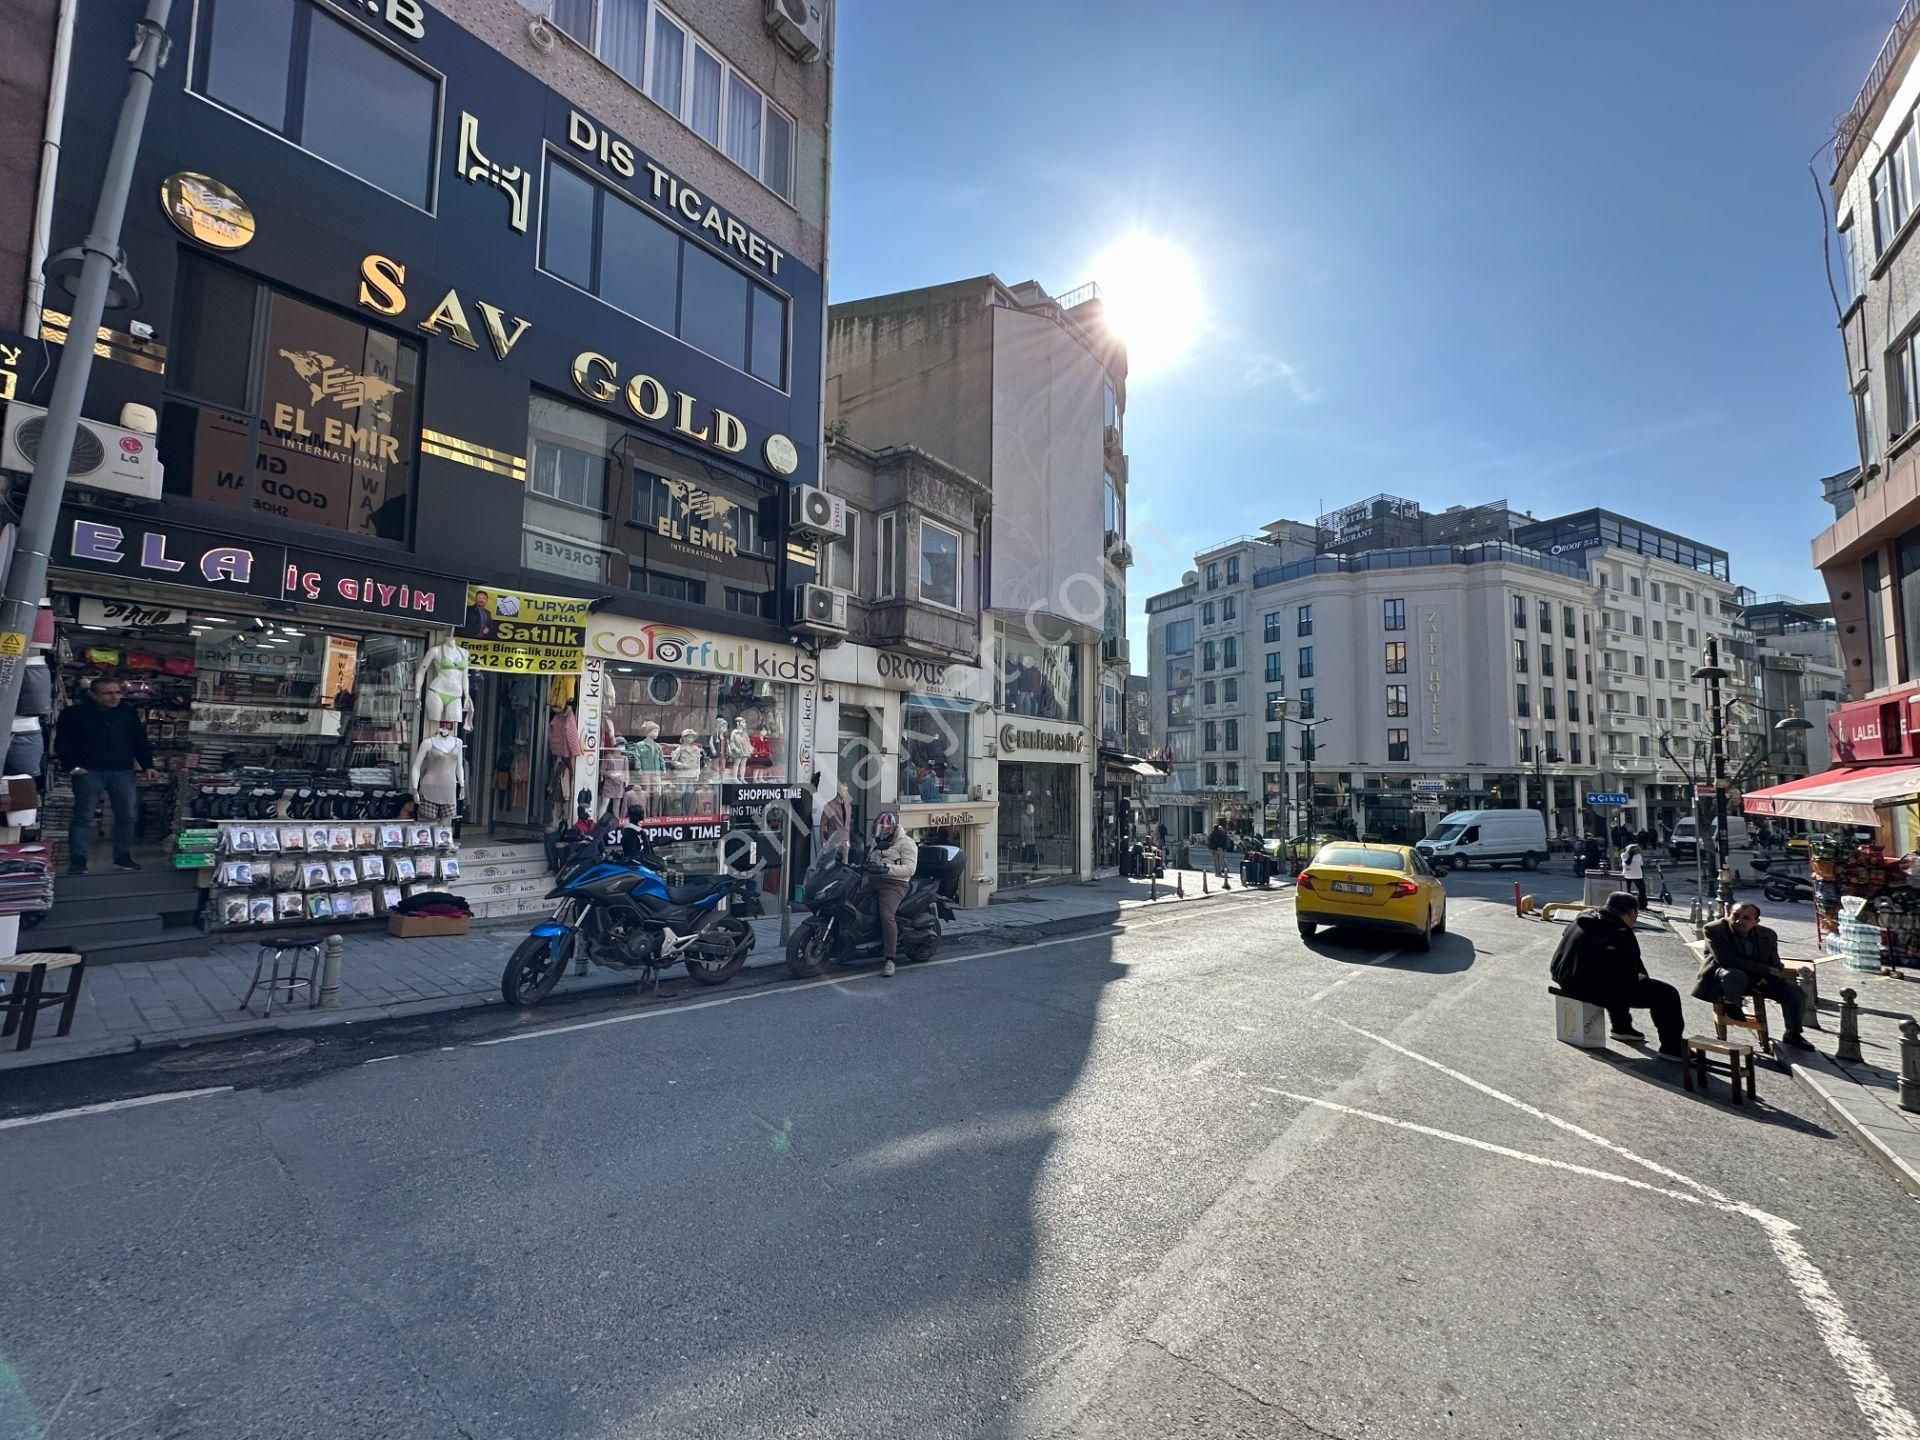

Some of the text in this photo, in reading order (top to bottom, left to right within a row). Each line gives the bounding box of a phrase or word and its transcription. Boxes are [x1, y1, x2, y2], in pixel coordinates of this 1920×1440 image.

[646, 161, 784, 276] TICARET
[358, 254, 748, 453] SAV GOLD
[274, 402, 400, 465] EL EMİR
[120, 453, 140, 464] LG
[281, 437, 386, 473] INTERNATIONAL
[71, 519, 254, 584] ELA
[658, 516, 738, 558] EL EMİR
[670, 543, 723, 563] INTERNATIONAL
[287, 564, 436, 613] İÇ GİYİM
[523, 598, 586, 614] TURYAP
[536, 612, 576, 624] ALPHA
[460, 640, 489, 651] Enes
[544, 648, 578, 658] BULUT
[496, 622, 578, 645] Satılık
[504, 656, 534, 670] 667
[538, 659, 556, 671] 62
[560, 660, 577, 670] 62
[591, 626, 815, 683] colorful kids
[876, 652, 945, 686] ORMUS
[583, 658, 601, 777] colorful kids
[802, 689, 812, 721] kids
[738, 788, 802, 801] SHOPPING TIME
[745, 805, 762, 816] TIME
[690, 825, 721, 839] TIME
